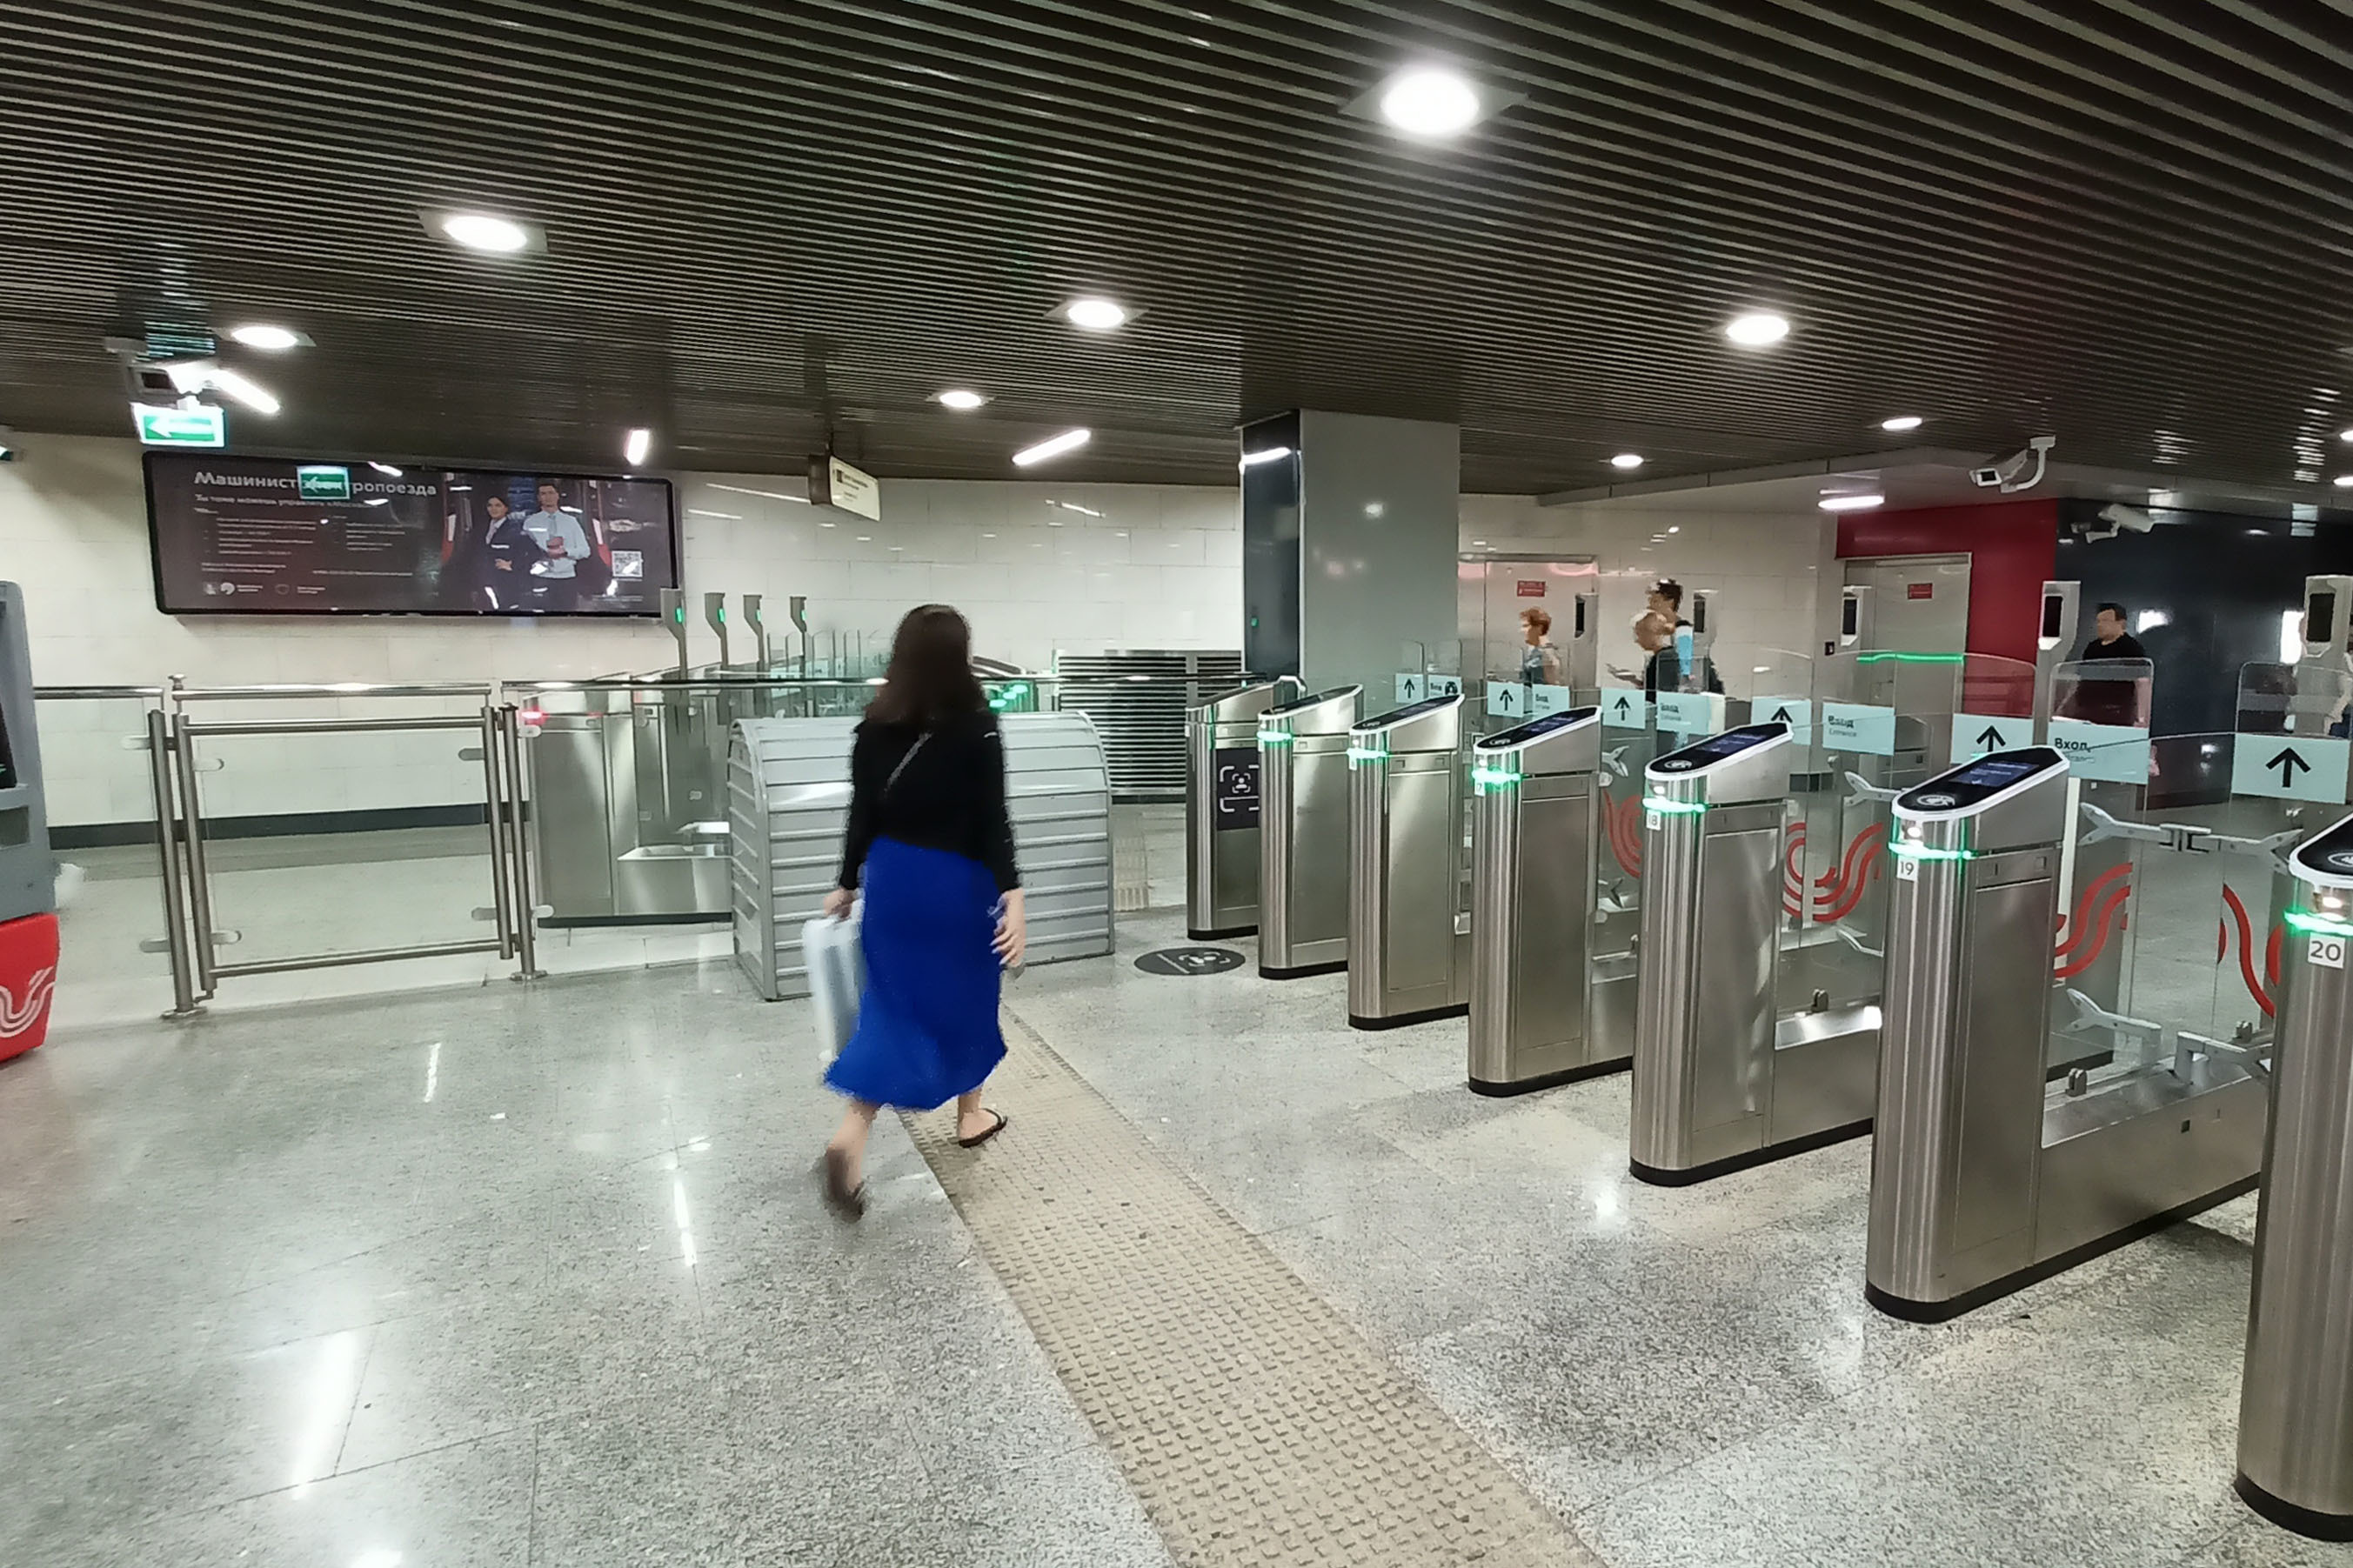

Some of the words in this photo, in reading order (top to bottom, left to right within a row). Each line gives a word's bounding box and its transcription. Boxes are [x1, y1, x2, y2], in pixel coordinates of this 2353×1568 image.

[193, 471, 297, 489] Машинист
[351, 482, 437, 497] ропоезда
[2054, 737, 2091, 753] Вход
[1900, 861, 1915, 876] 19
[2310, 940, 2342, 962] 20
